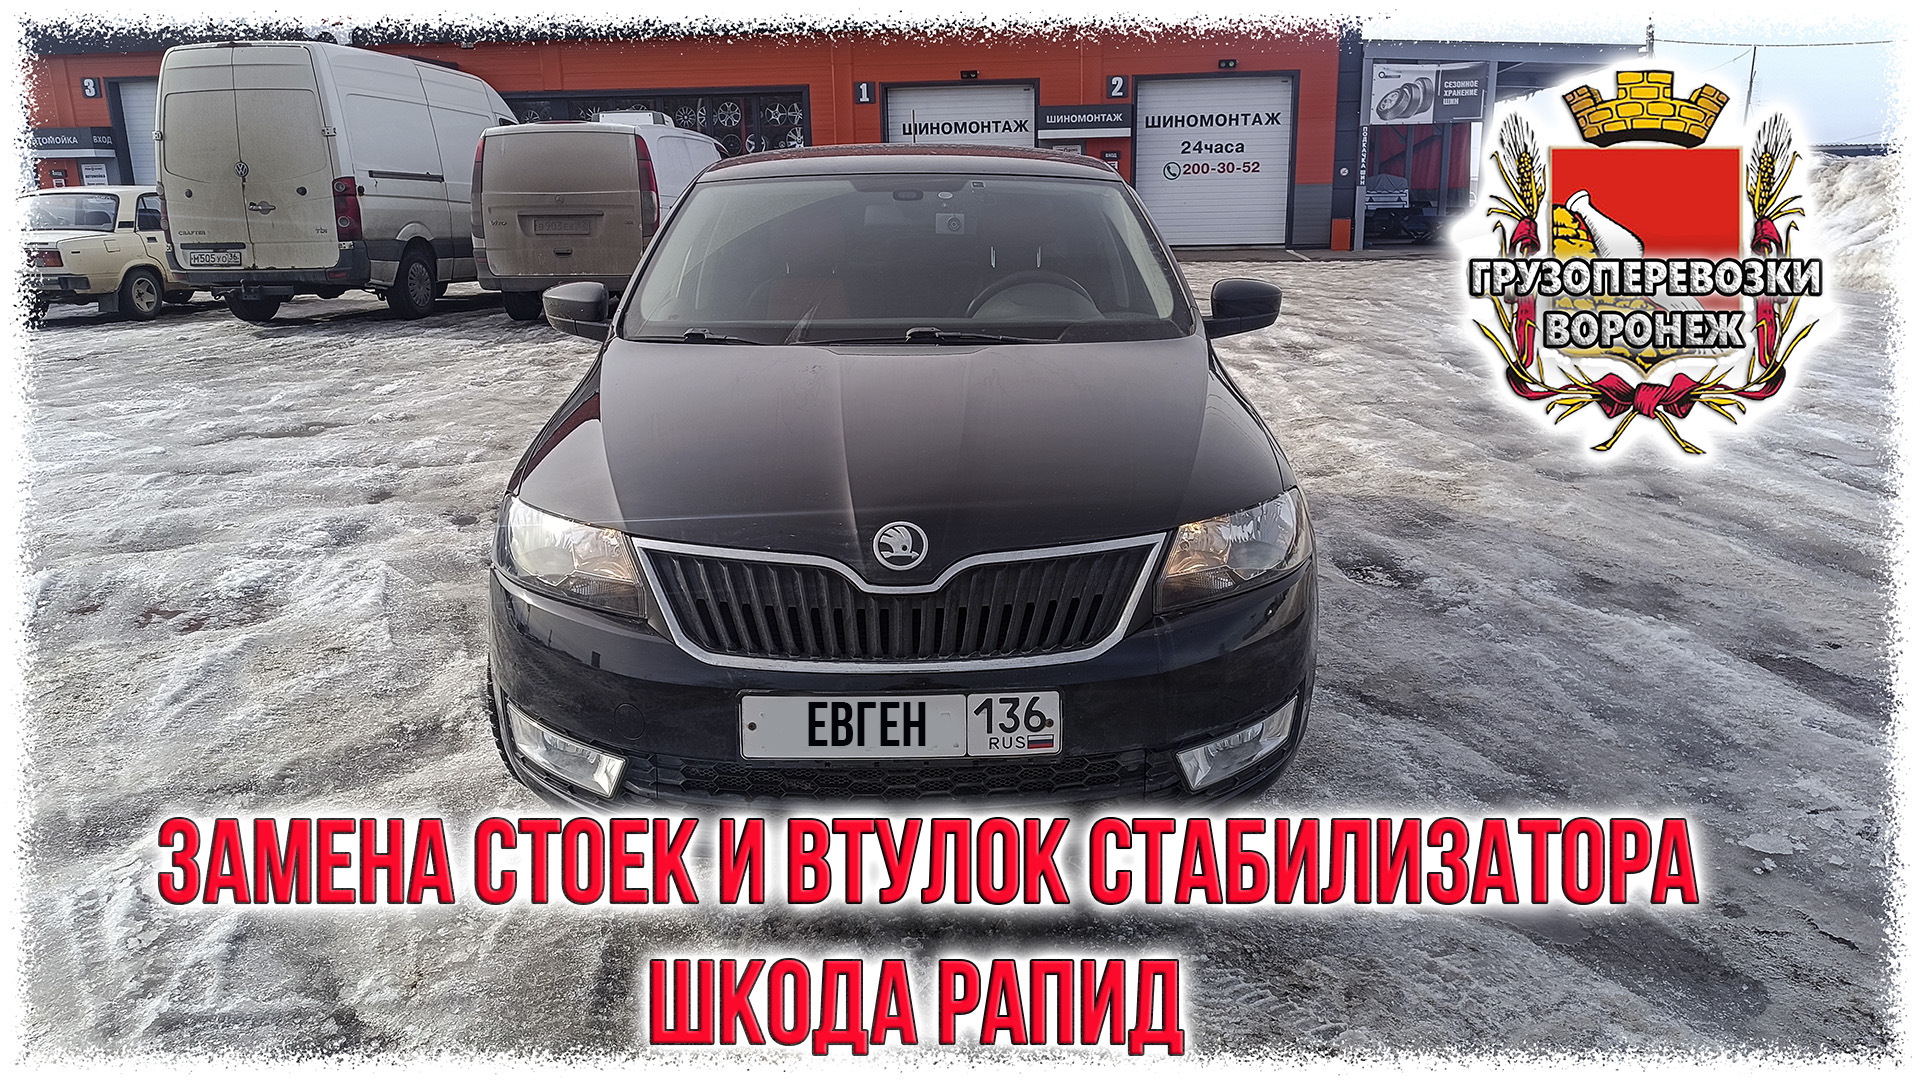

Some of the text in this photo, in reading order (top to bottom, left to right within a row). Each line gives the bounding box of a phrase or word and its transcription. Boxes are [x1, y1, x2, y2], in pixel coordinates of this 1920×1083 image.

[83, 78, 96, 97] 3
[1111, 76, 1124, 97] 2
[1443, 80, 1479, 88] СЕЗОННОЕ
[859, 83, 870, 102] 1
[1443, 88, 1478, 97] ХРАНЕНИЕ
[1046, 113, 1123, 124] ШИНОМОНТАЖ
[1145, 112, 1282, 129] ШИНОМОНТАЖ
[902, 119, 1029, 136] ШИНОМОНТАЖ
[92, 135, 113, 145] ВХОД
[1183, 161, 1261, 175] 200-30-52
[972, 696, 1048, 735] 136
[988, 736, 1026, 751] RUS
